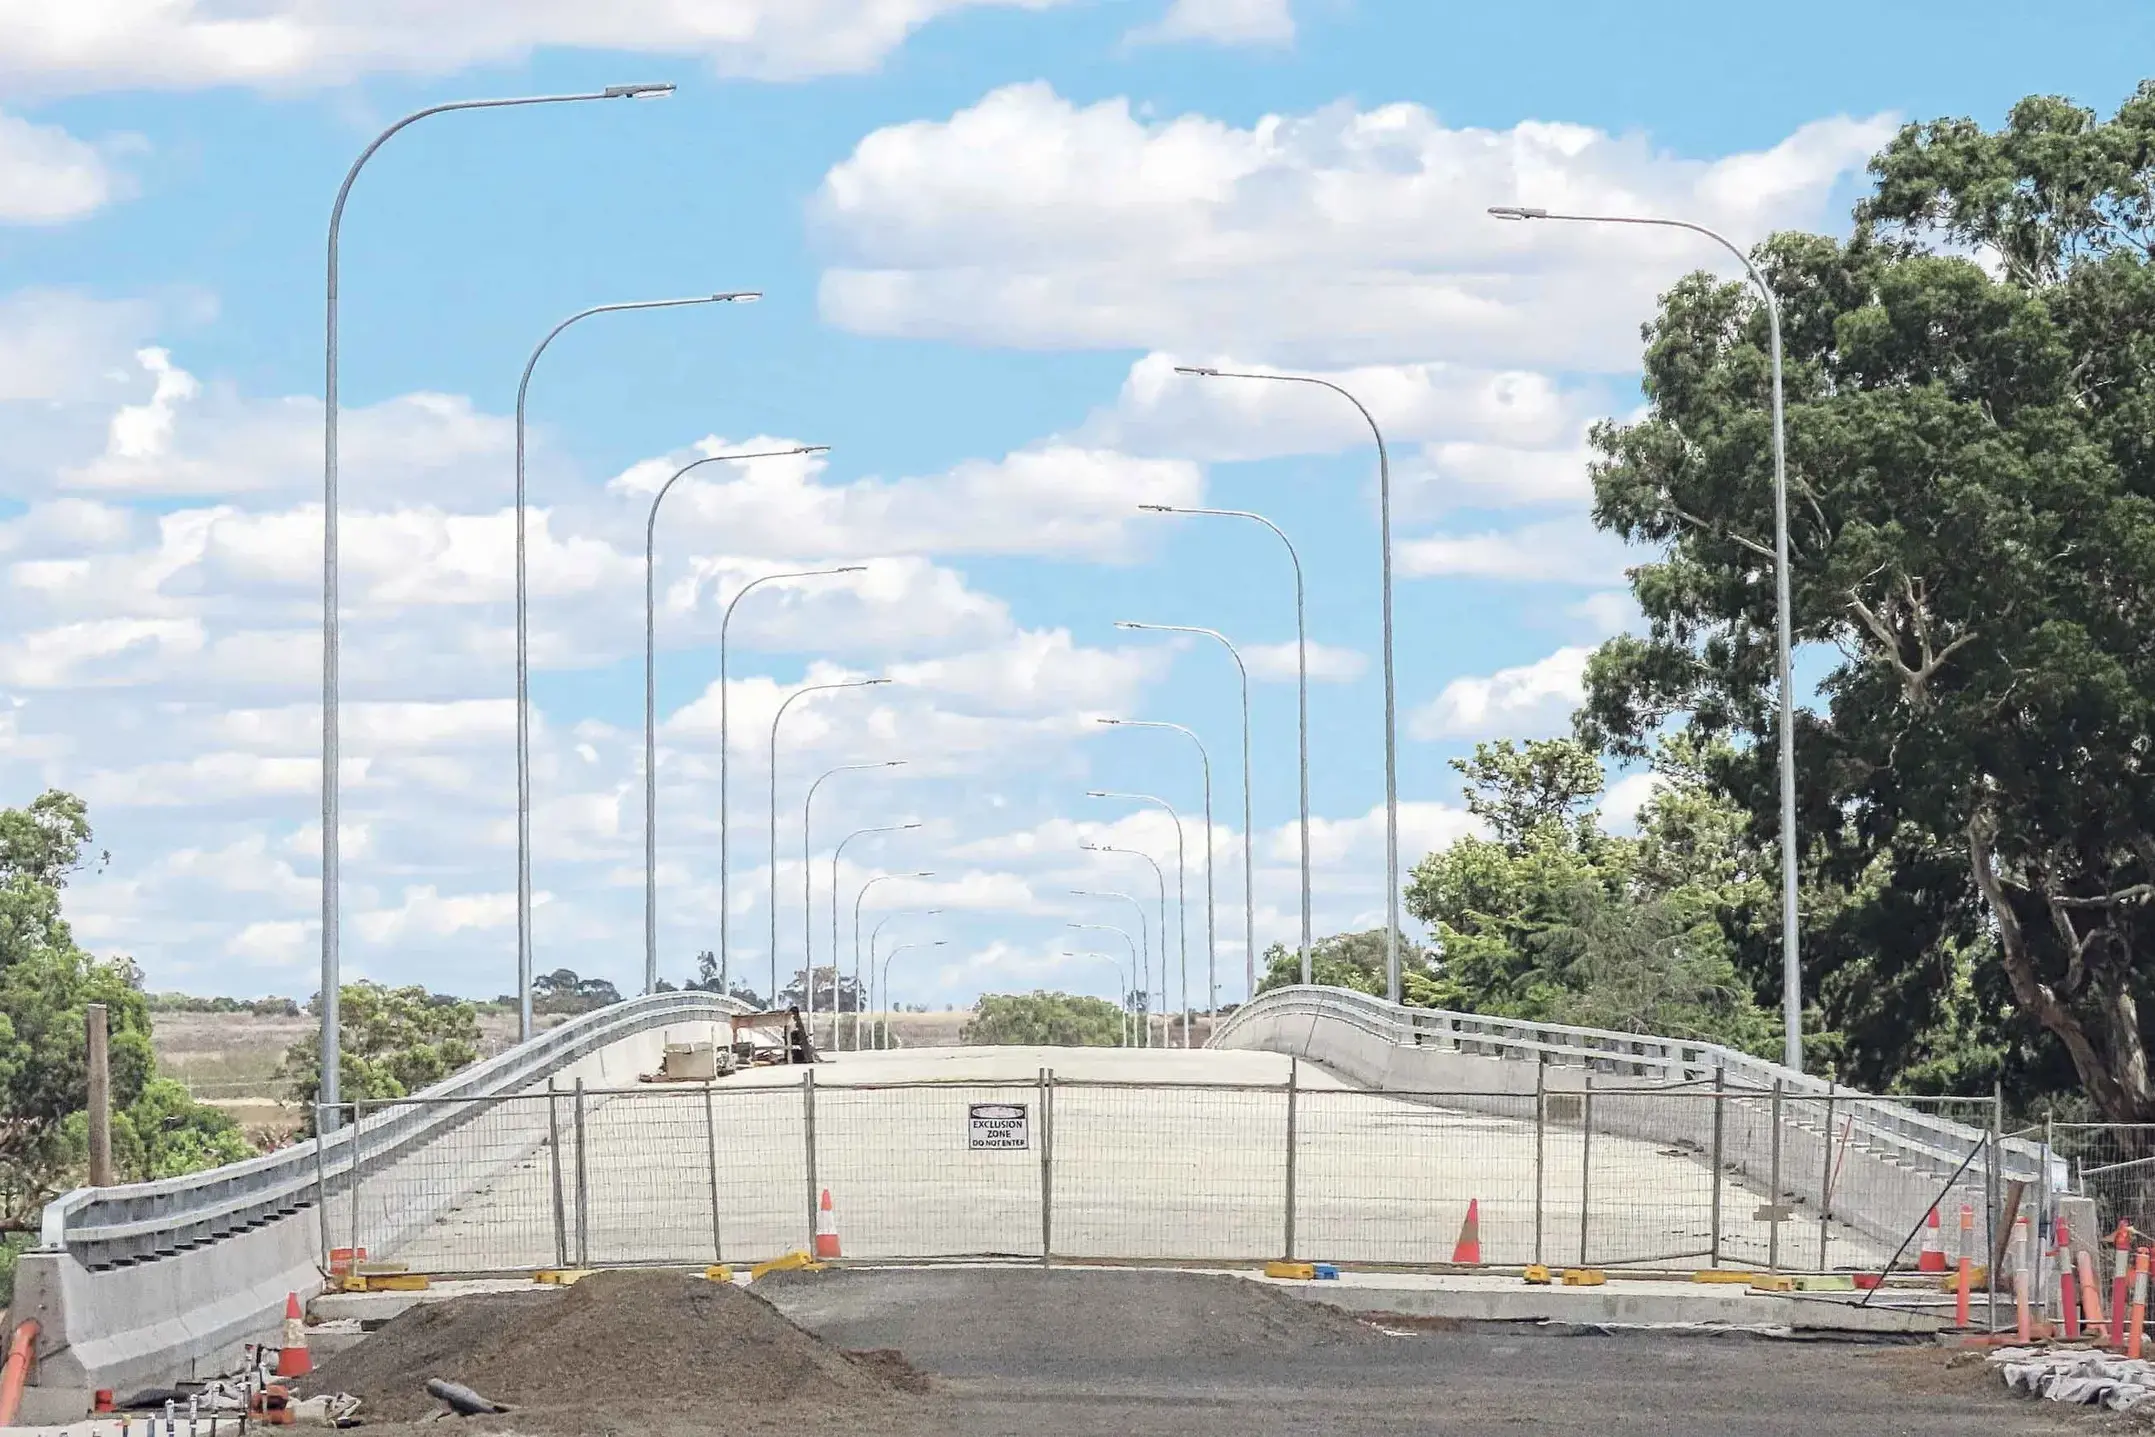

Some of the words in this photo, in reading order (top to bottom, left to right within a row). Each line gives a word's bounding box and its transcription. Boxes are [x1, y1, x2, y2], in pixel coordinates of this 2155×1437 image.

[973, 1120, 1022, 1128] EXCLUSION
[987, 1130, 1011, 1138] ZONE
[972, 1139, 984, 1147] DO
[986, 1139, 1000, 1147] NOT
[1002, 1139, 1025, 1147] ENTER
